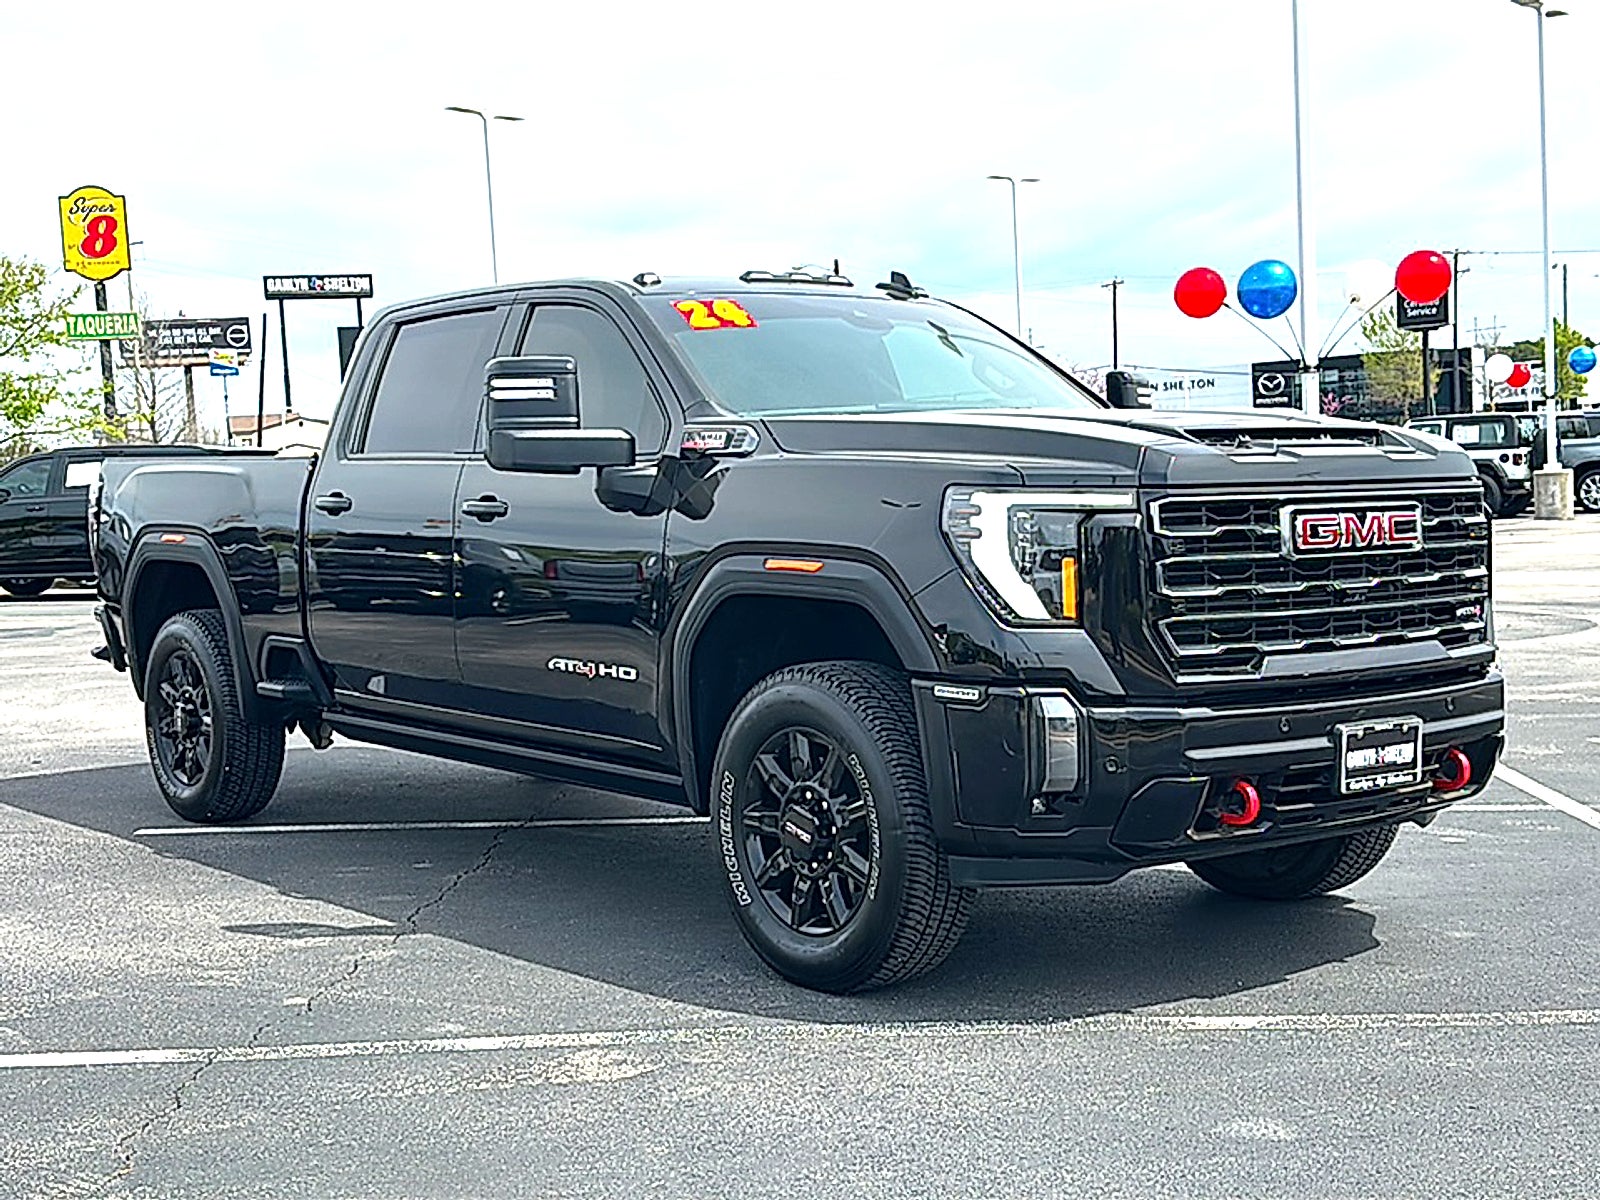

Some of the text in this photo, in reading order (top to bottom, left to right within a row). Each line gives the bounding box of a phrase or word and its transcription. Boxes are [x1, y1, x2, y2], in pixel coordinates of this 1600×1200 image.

[69, 196, 115, 222] Super
[79, 214, 118, 259] 8
[323, 276, 371, 292] SHELTON
[1406, 306, 1438, 318] Service
[67, 314, 138, 337] TAQUERIA
[1163, 378, 1216, 392] SHETON
[1295, 510, 1421, 550] GMC
[719, 770, 752, 907] MICHELIN
